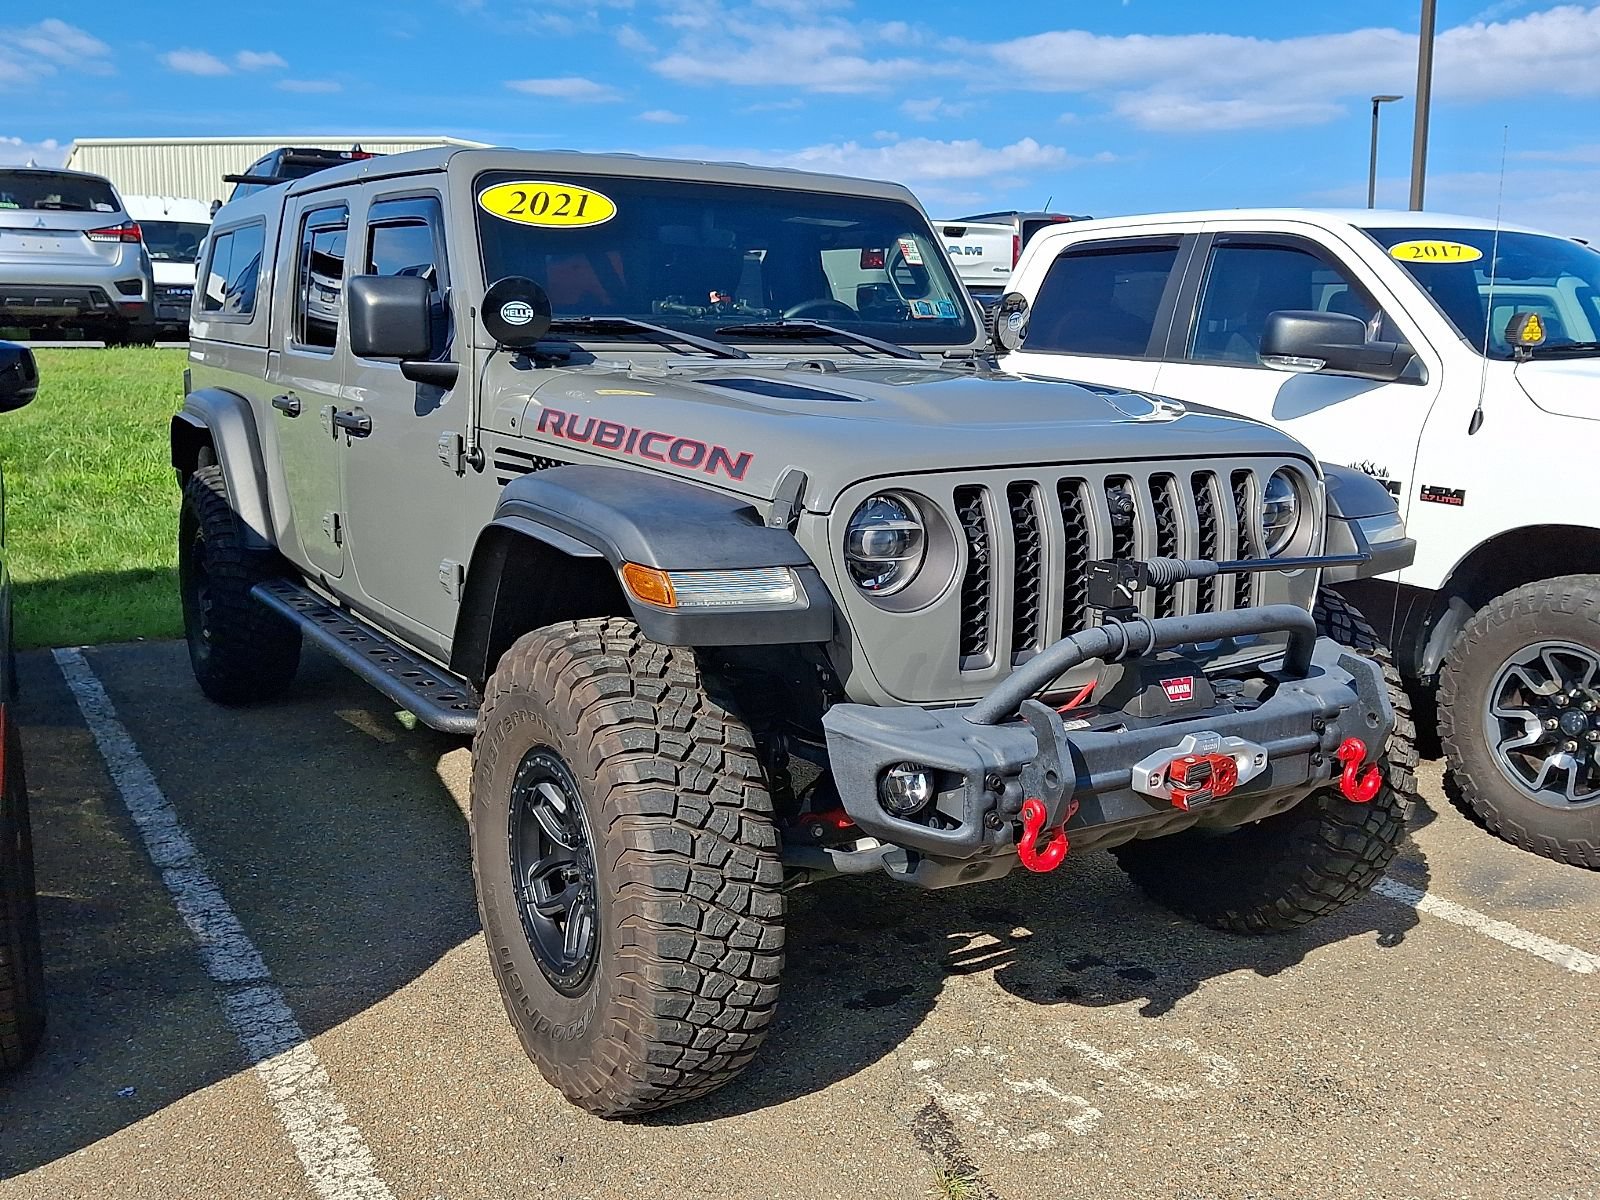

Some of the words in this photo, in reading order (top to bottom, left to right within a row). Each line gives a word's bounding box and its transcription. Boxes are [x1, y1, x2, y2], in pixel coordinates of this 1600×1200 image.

[506, 191, 589, 218] 2021
[947, 245, 983, 256] AM
[1408, 245, 1462, 259] 2017
[503, 307, 534, 318] HELLA
[536, 407, 754, 482] RUBICON
[1436, 494, 1463, 505] LITER
[1166, 683, 1191, 695] WARN
[500, 946, 599, 1042] Goodrich
